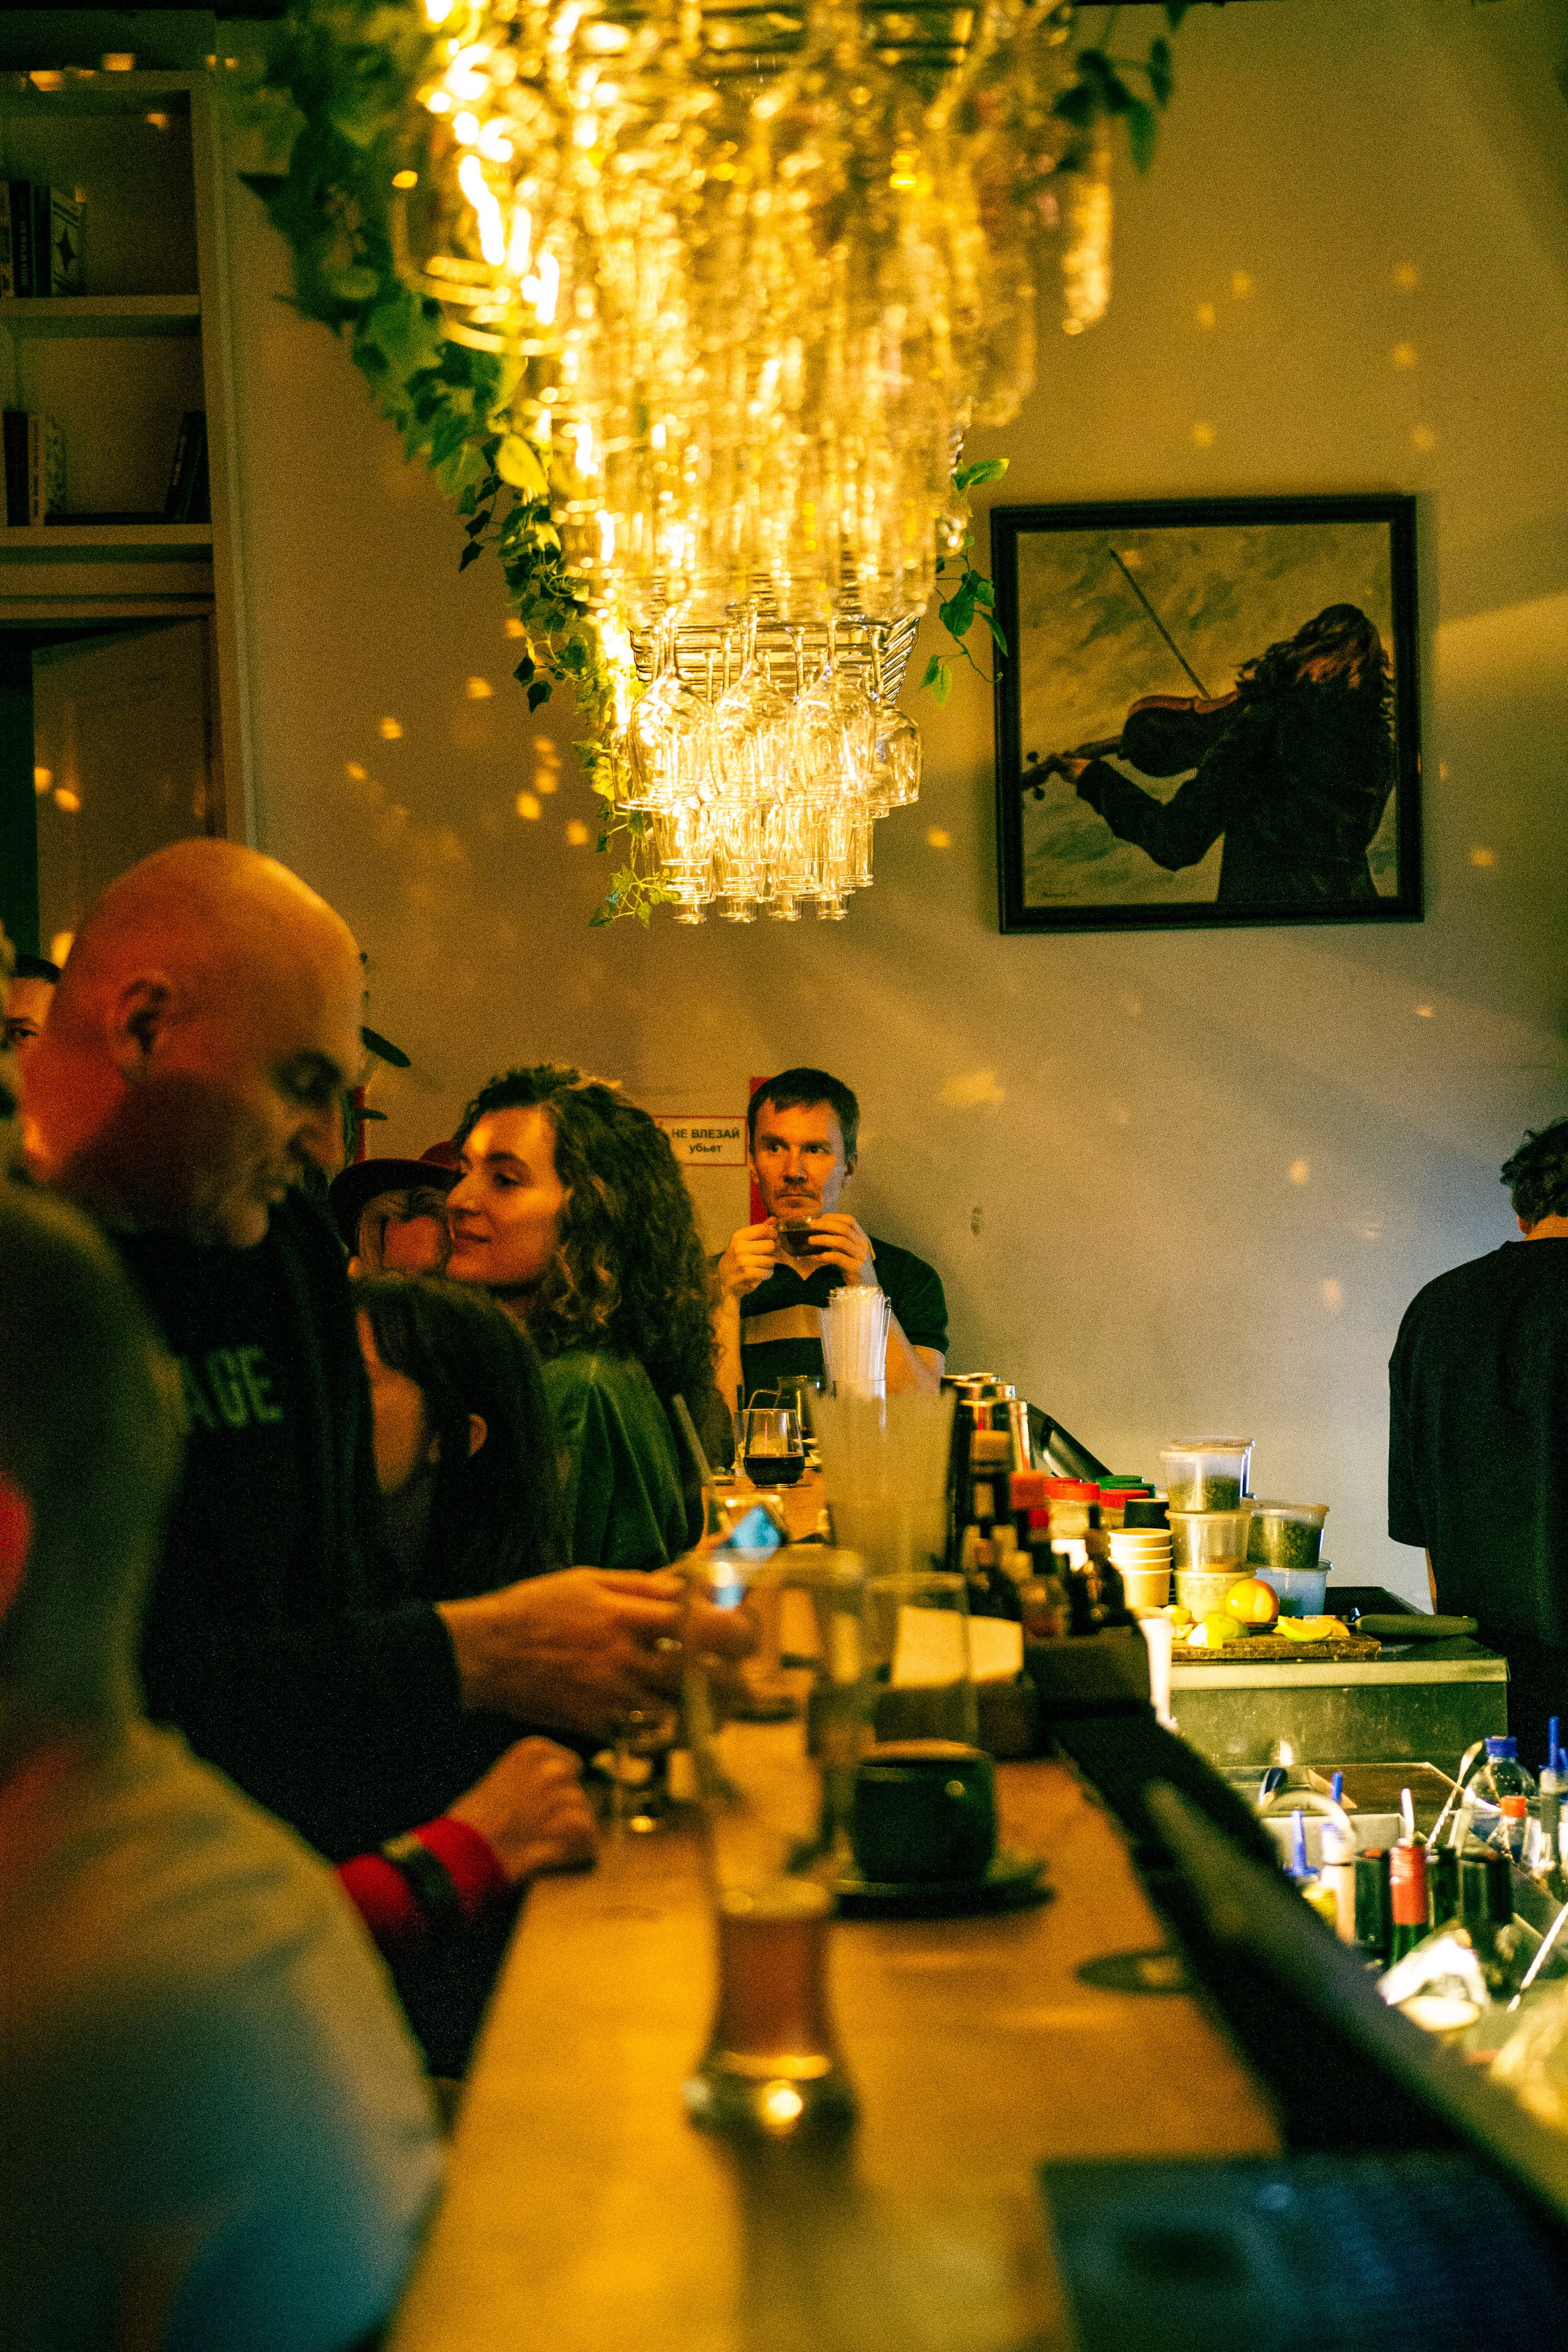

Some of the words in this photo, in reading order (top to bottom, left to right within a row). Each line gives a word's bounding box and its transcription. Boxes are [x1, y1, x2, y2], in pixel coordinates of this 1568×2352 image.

[671, 1129, 688, 1139] НЕ
[691, 1127, 740, 1139] ВЛЕЗАЙ
[689, 1142, 723, 1155] убьет
